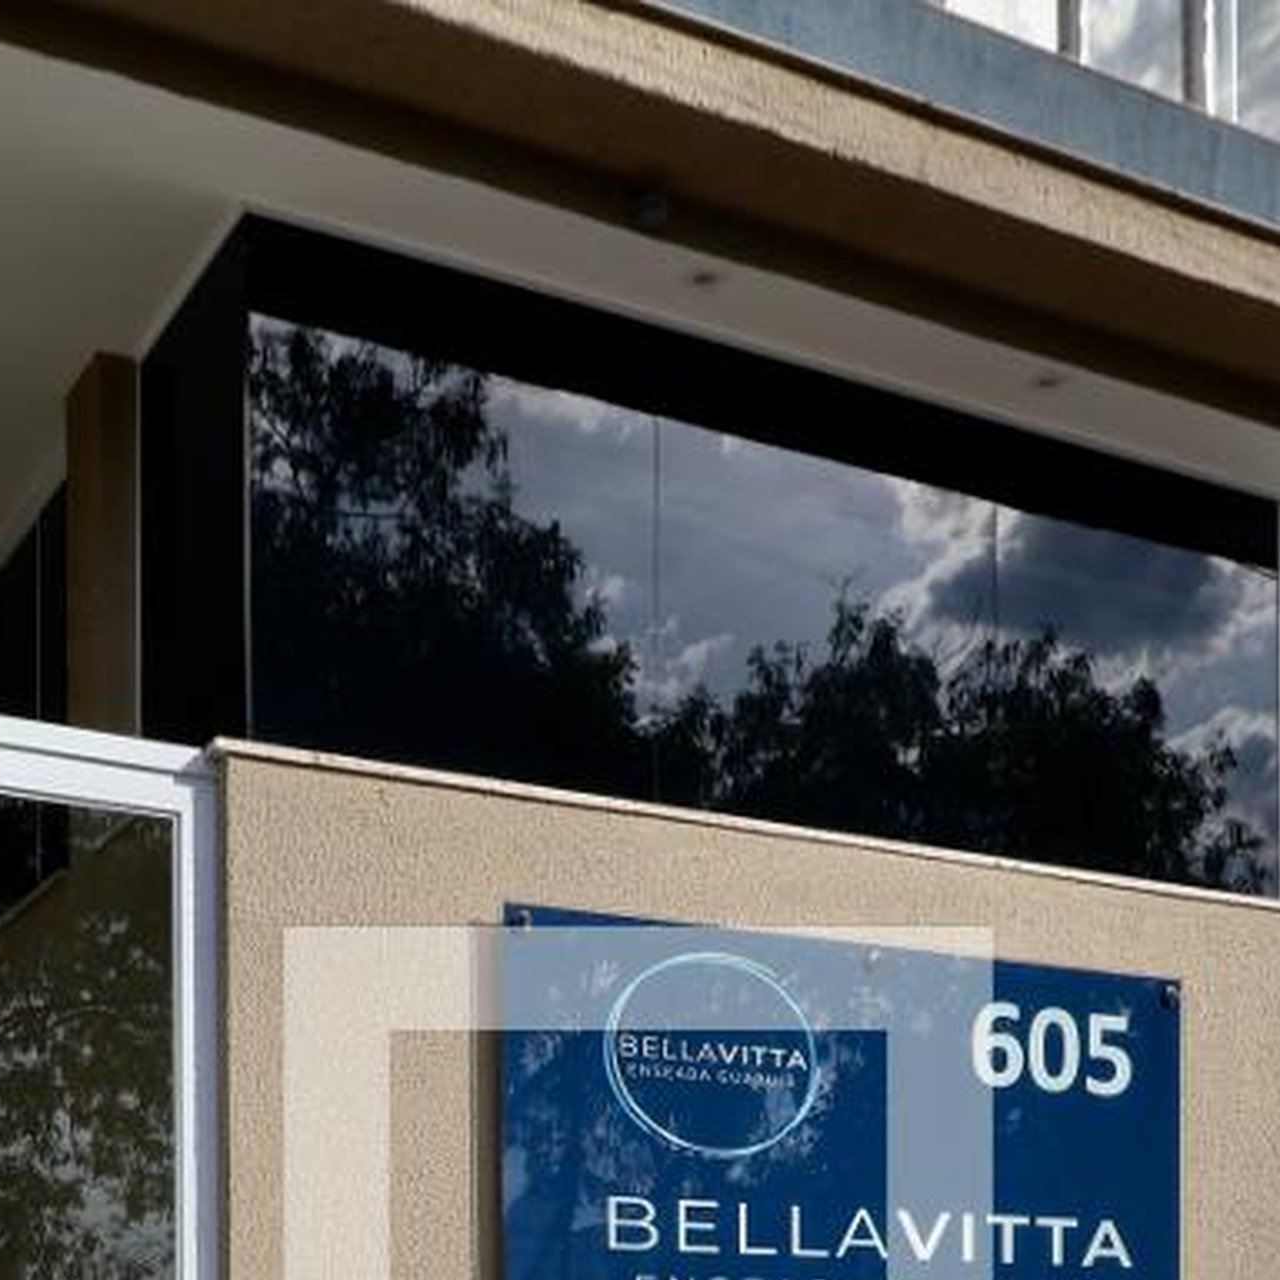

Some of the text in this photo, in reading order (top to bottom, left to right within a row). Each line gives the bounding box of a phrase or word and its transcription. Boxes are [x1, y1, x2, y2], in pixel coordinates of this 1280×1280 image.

[619, 1032, 808, 1071] BELLAVITTA
[972, 1001, 1133, 1097] 605
[607, 1195, 1133, 1268] BELLAVITTA
